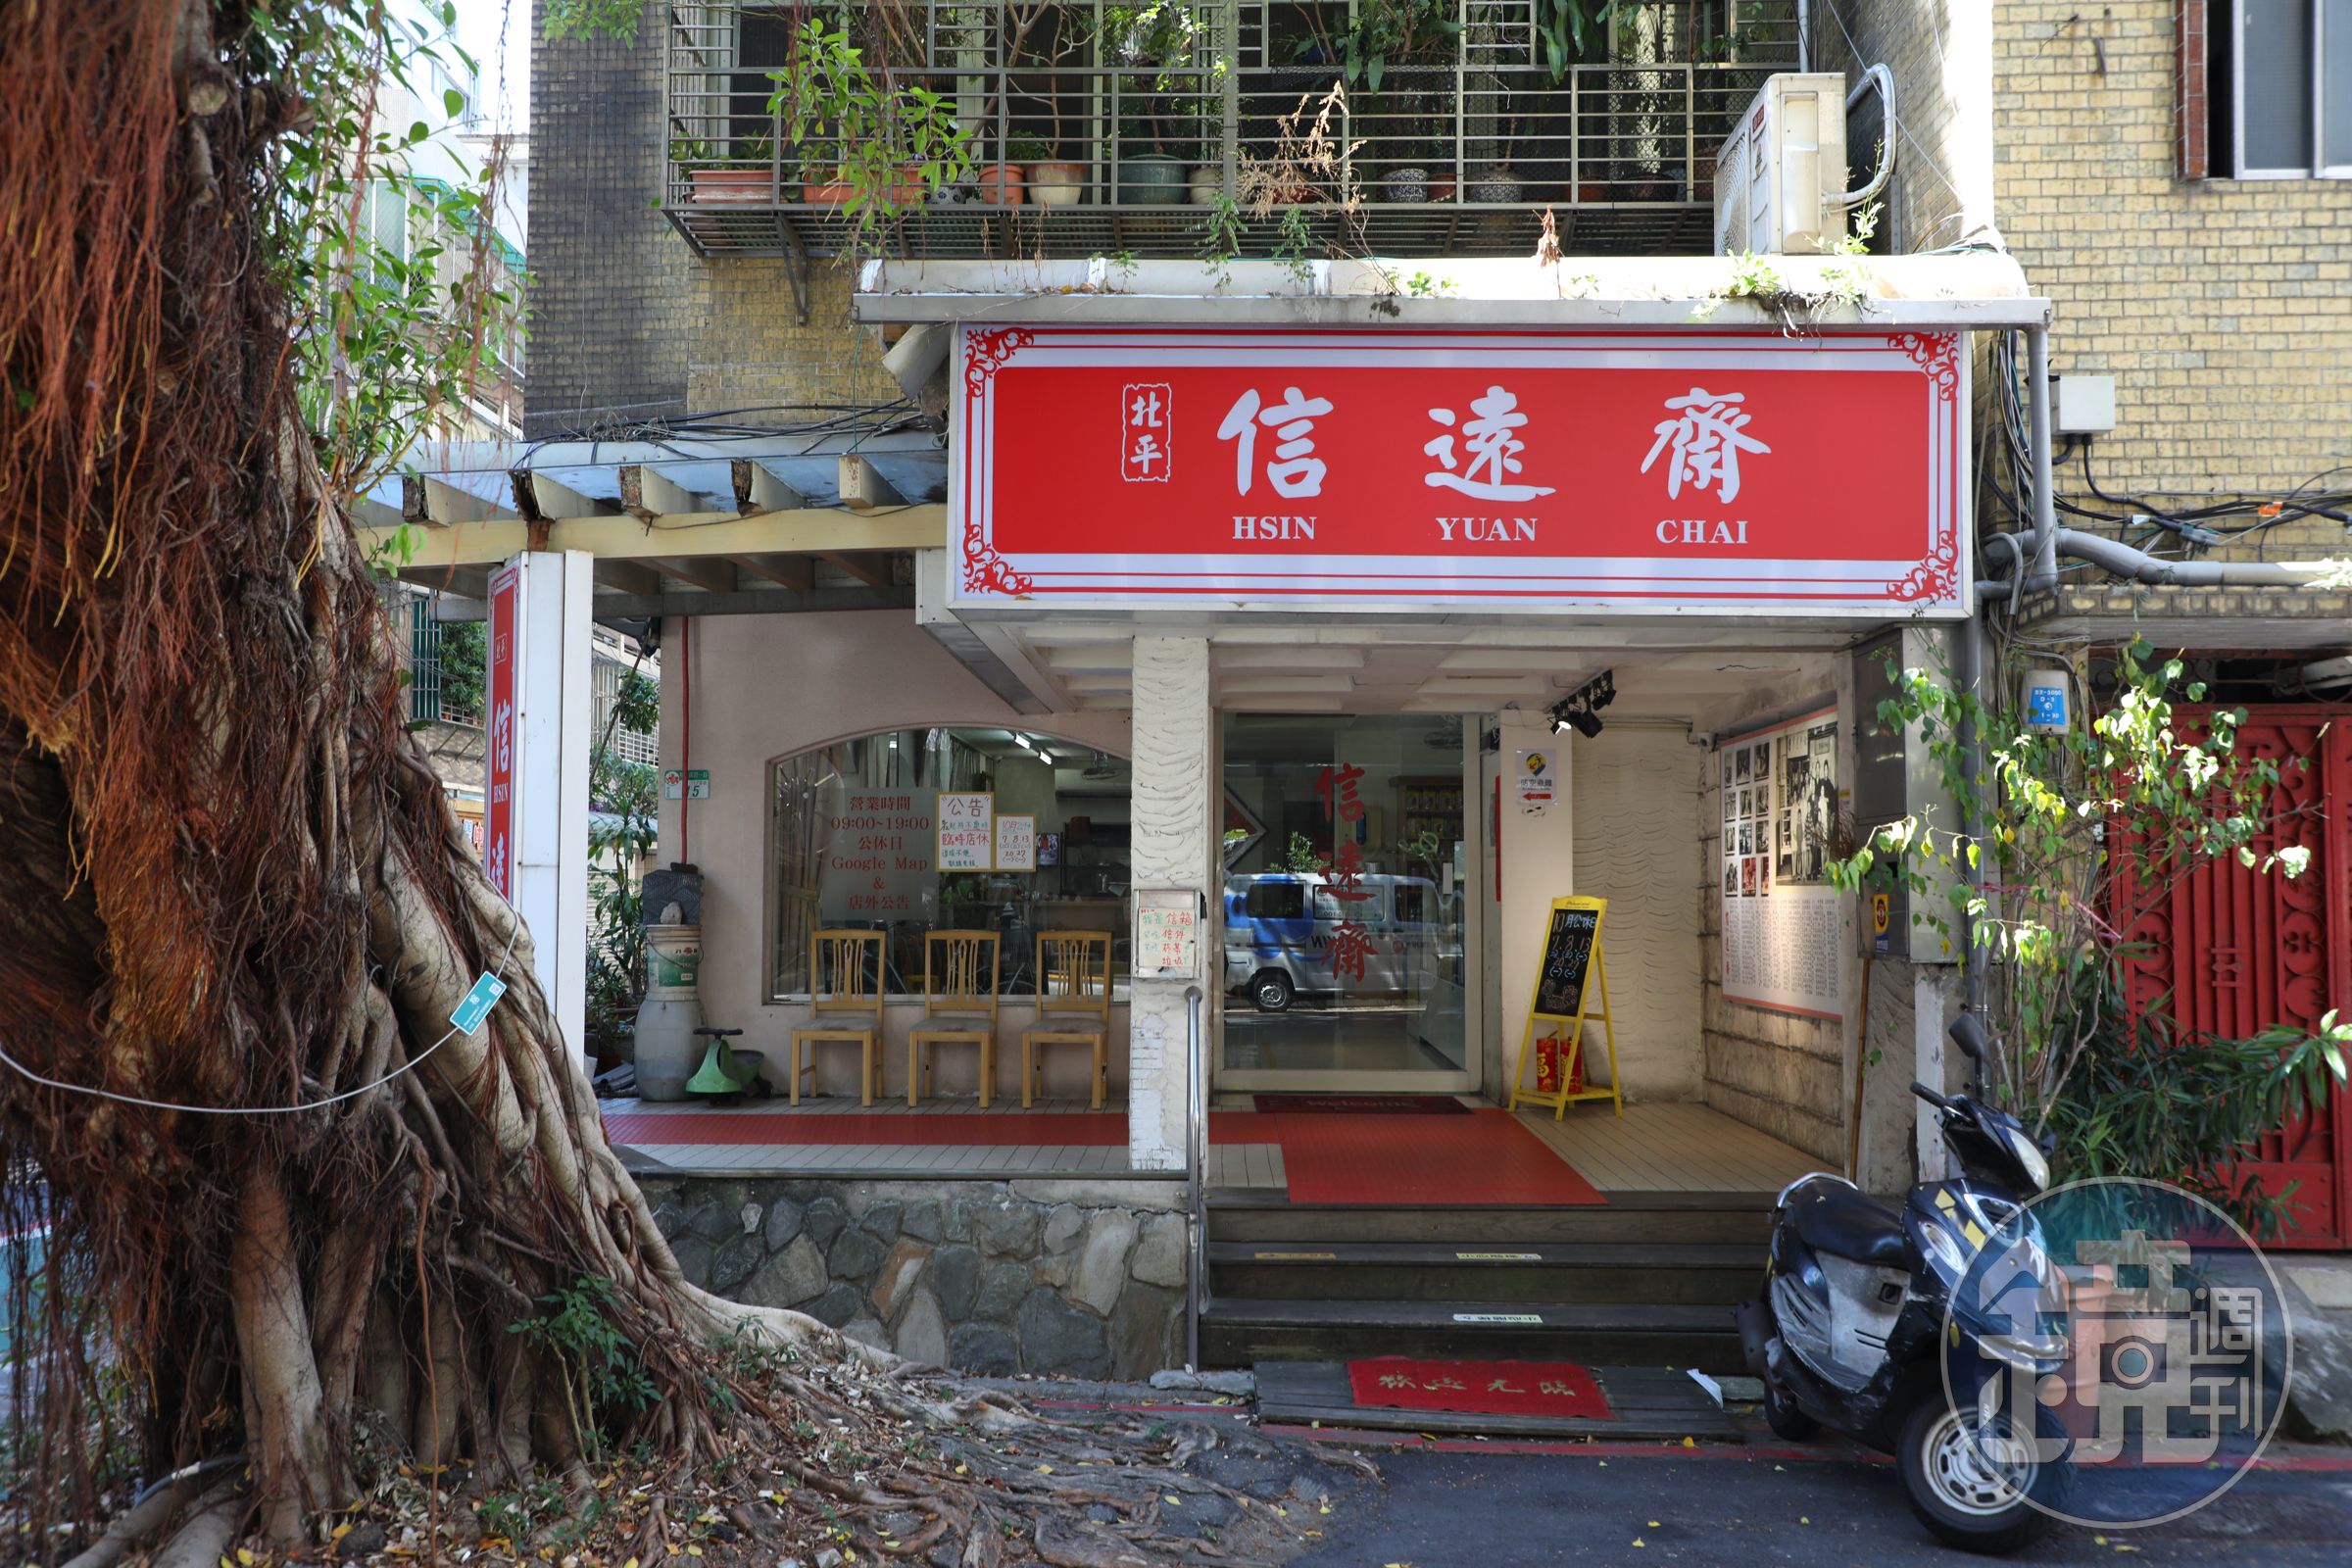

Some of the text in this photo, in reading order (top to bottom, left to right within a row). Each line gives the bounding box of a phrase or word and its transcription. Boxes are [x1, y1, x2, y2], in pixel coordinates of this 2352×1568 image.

[1130, 391, 1163, 474] 北平
[1232, 515, 1748, 544] HSIN YUAN CHAI
[493, 783, 509, 804] HSIN
[850, 796, 910, 811] 營業時間
[858, 835, 904, 851] 公休日
[831, 856, 929, 871] Google Map
[873, 876, 885, 890] &
[849, 894, 910, 910] 店外公告
